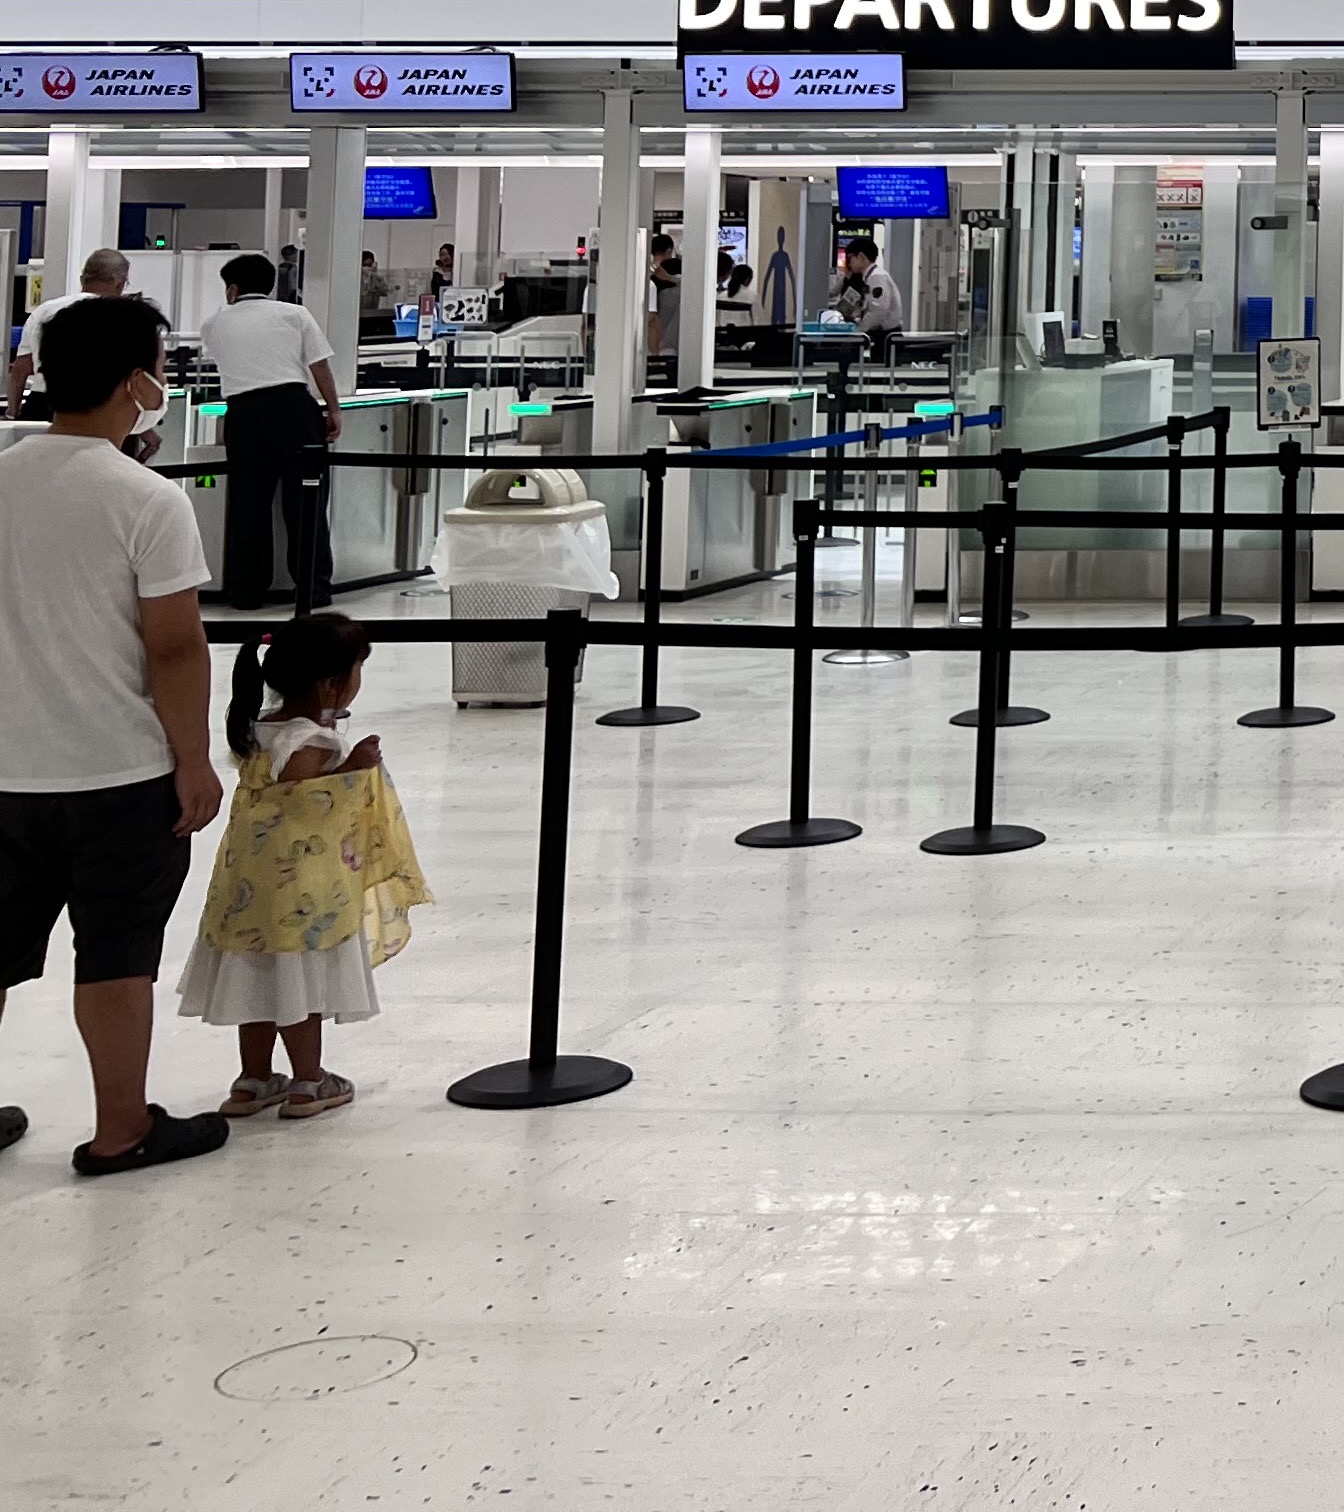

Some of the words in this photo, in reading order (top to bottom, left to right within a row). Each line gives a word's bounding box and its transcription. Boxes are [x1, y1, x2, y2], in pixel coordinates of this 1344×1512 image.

[85, 69, 155, 81] JAPAN
[398, 69, 468, 80] JAPAN
[790, 69, 859, 80] JAPAN
[90, 84, 193, 96] AIRLINES
[401, 84, 505, 96] AIRLINES
[794, 84, 896, 96] AIRLINES
